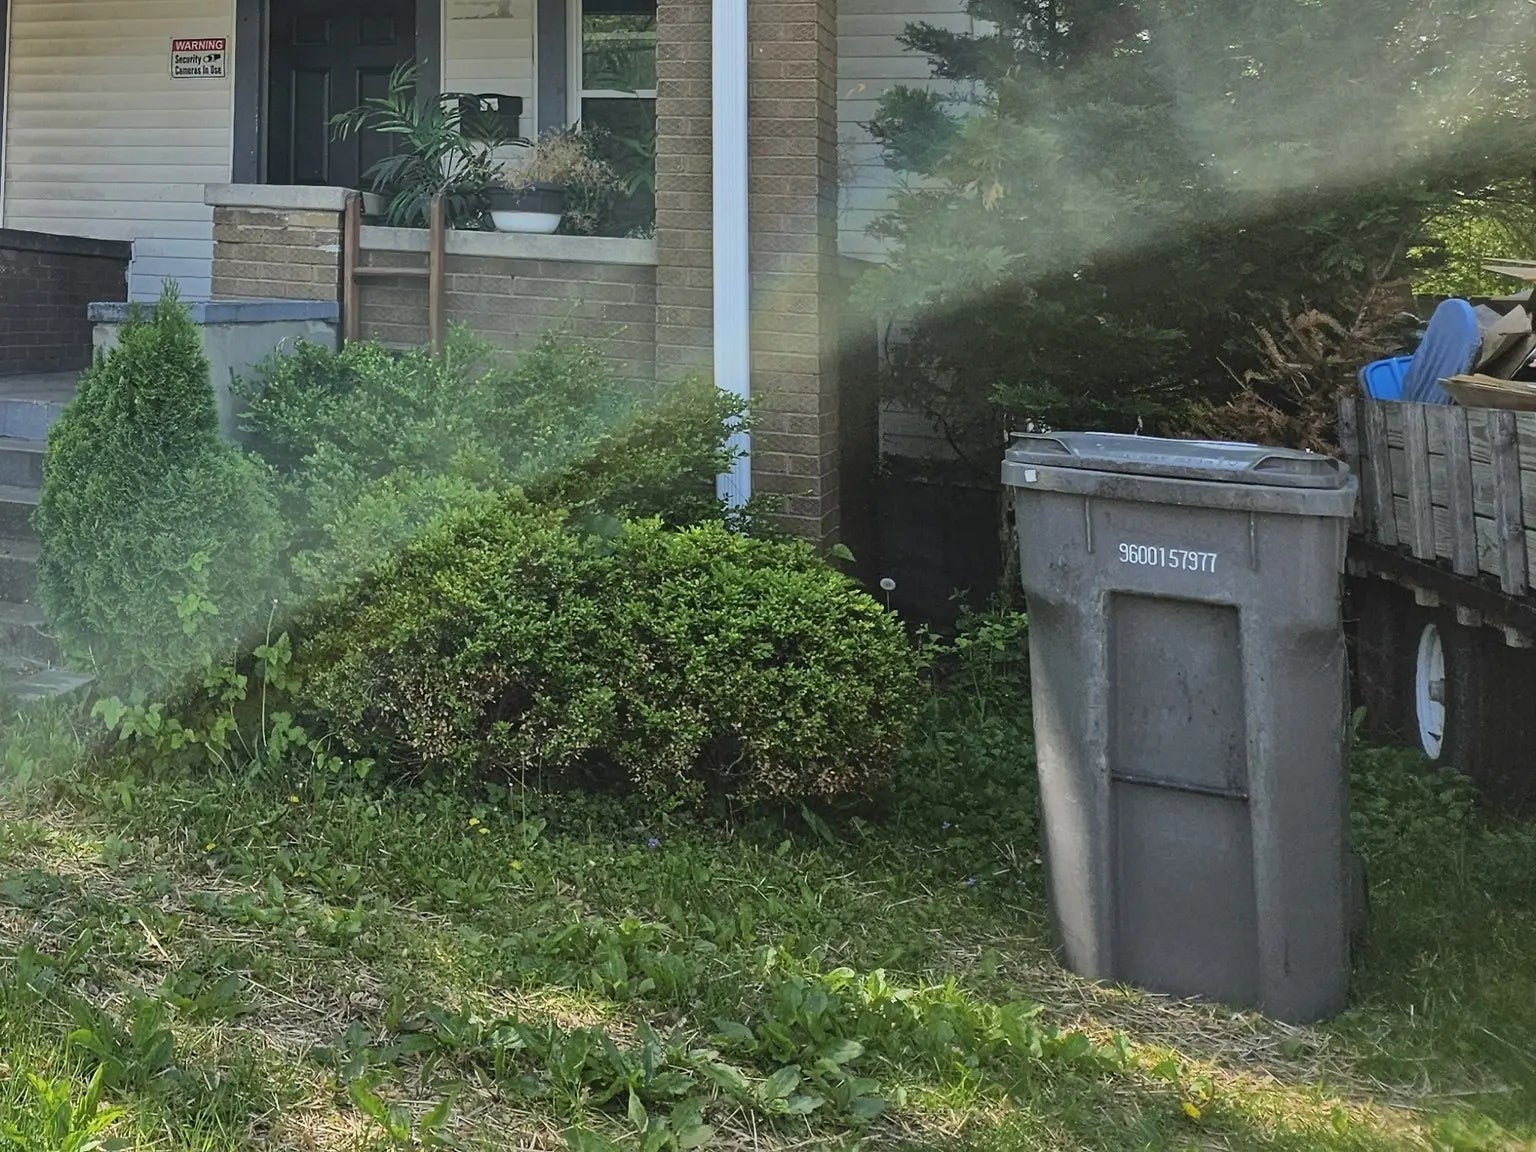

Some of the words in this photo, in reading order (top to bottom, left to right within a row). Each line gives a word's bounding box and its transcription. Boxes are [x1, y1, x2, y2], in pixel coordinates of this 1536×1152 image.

[175, 40, 223, 50] WARNING
[175, 54, 202, 65] Security
[175, 66, 201, 75] Cameras
[210, 65, 222, 75] Use
[1119, 543, 1217, 573] 9600157977
